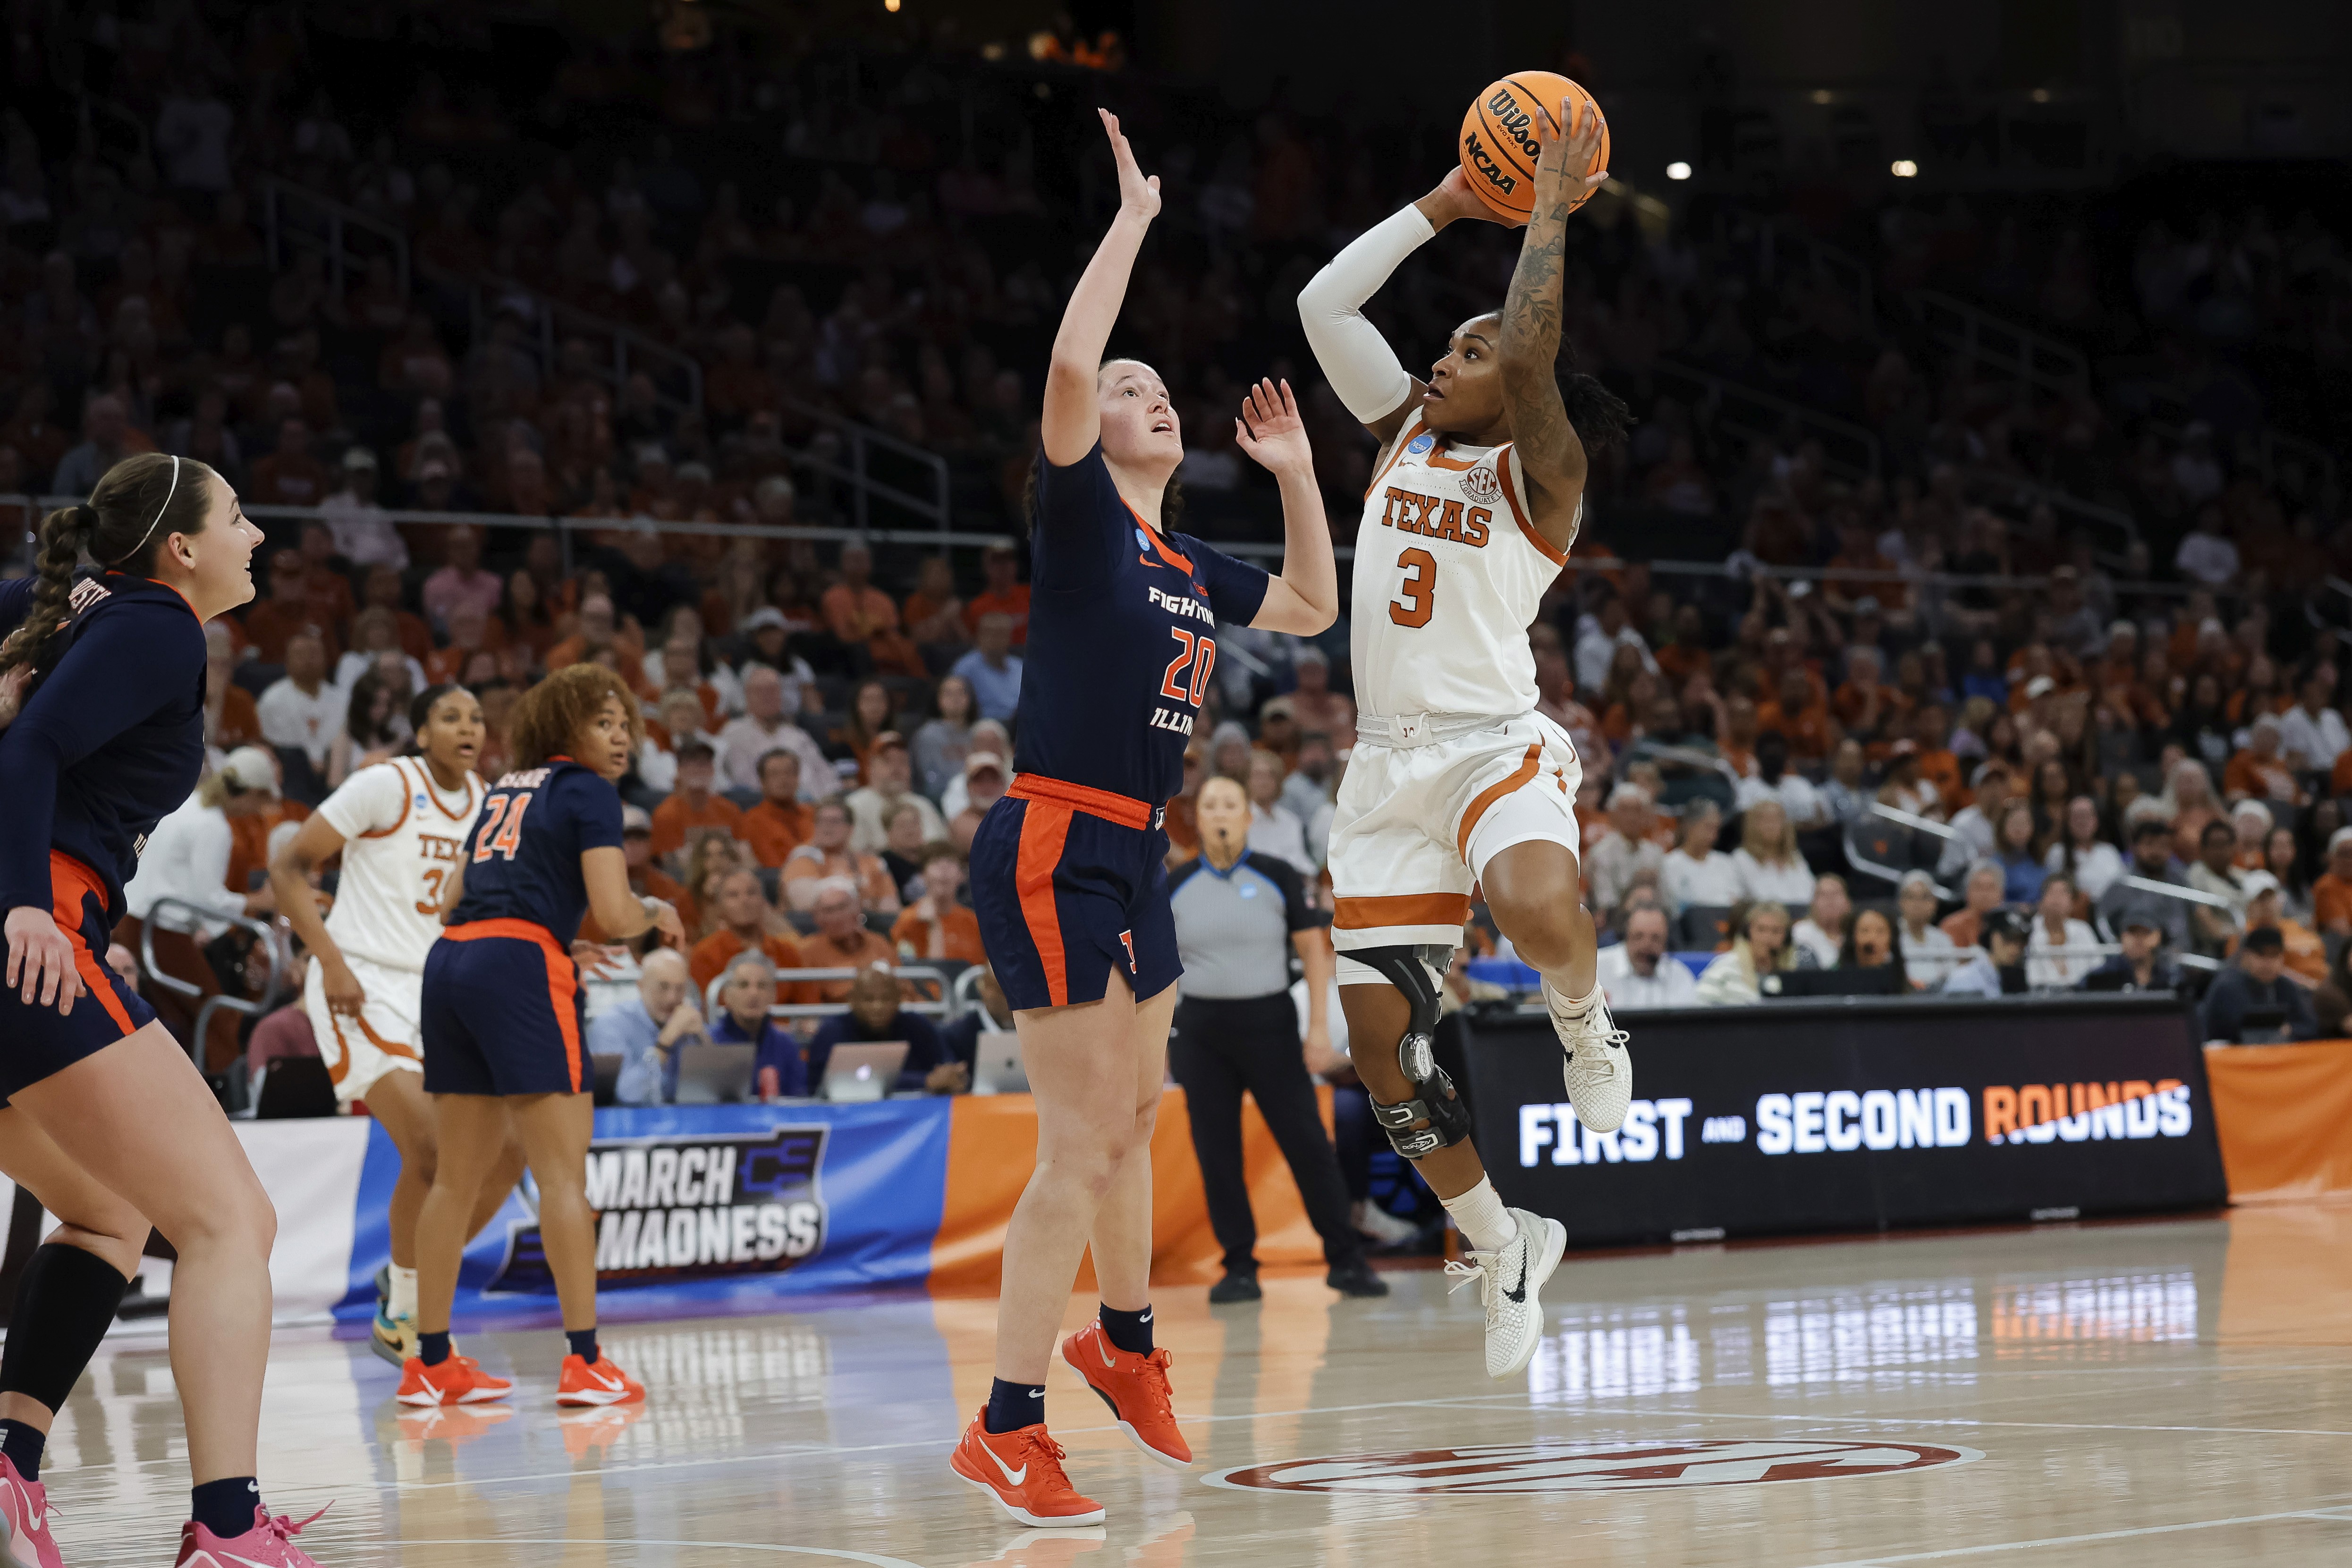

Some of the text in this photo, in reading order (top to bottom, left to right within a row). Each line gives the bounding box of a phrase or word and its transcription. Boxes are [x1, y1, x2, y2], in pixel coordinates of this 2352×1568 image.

[1487, 88, 1541, 165] Wilso
[1496, 124, 1518, 150] EVO NXT
[1465, 131, 1517, 196] NCAA
[1463, 487, 1496, 503] GRADUATE
[1469, 467, 1497, 495] SEC
[1382, 486, 1492, 548] TEXAS
[1149, 586, 1216, 629] FIGHTIN
[1389, 547, 1437, 629] 3
[1159, 625, 1216, 708] 20
[1150, 707, 1194, 737] ILLIN
[474, 792, 533, 863] 24
[1419, 1042, 1428, 1075] DONJOY
[1402, 1139, 1431, 1149] DONJOY
[1519, 1098, 1693, 1167] FIRST
[1756, 1087, 1972, 1154] SECOND
[1983, 1078, 2193, 1146] ROUNDS
[584, 1146, 737, 1210] MARCH
[595, 1202, 820, 1271] MADNESS
